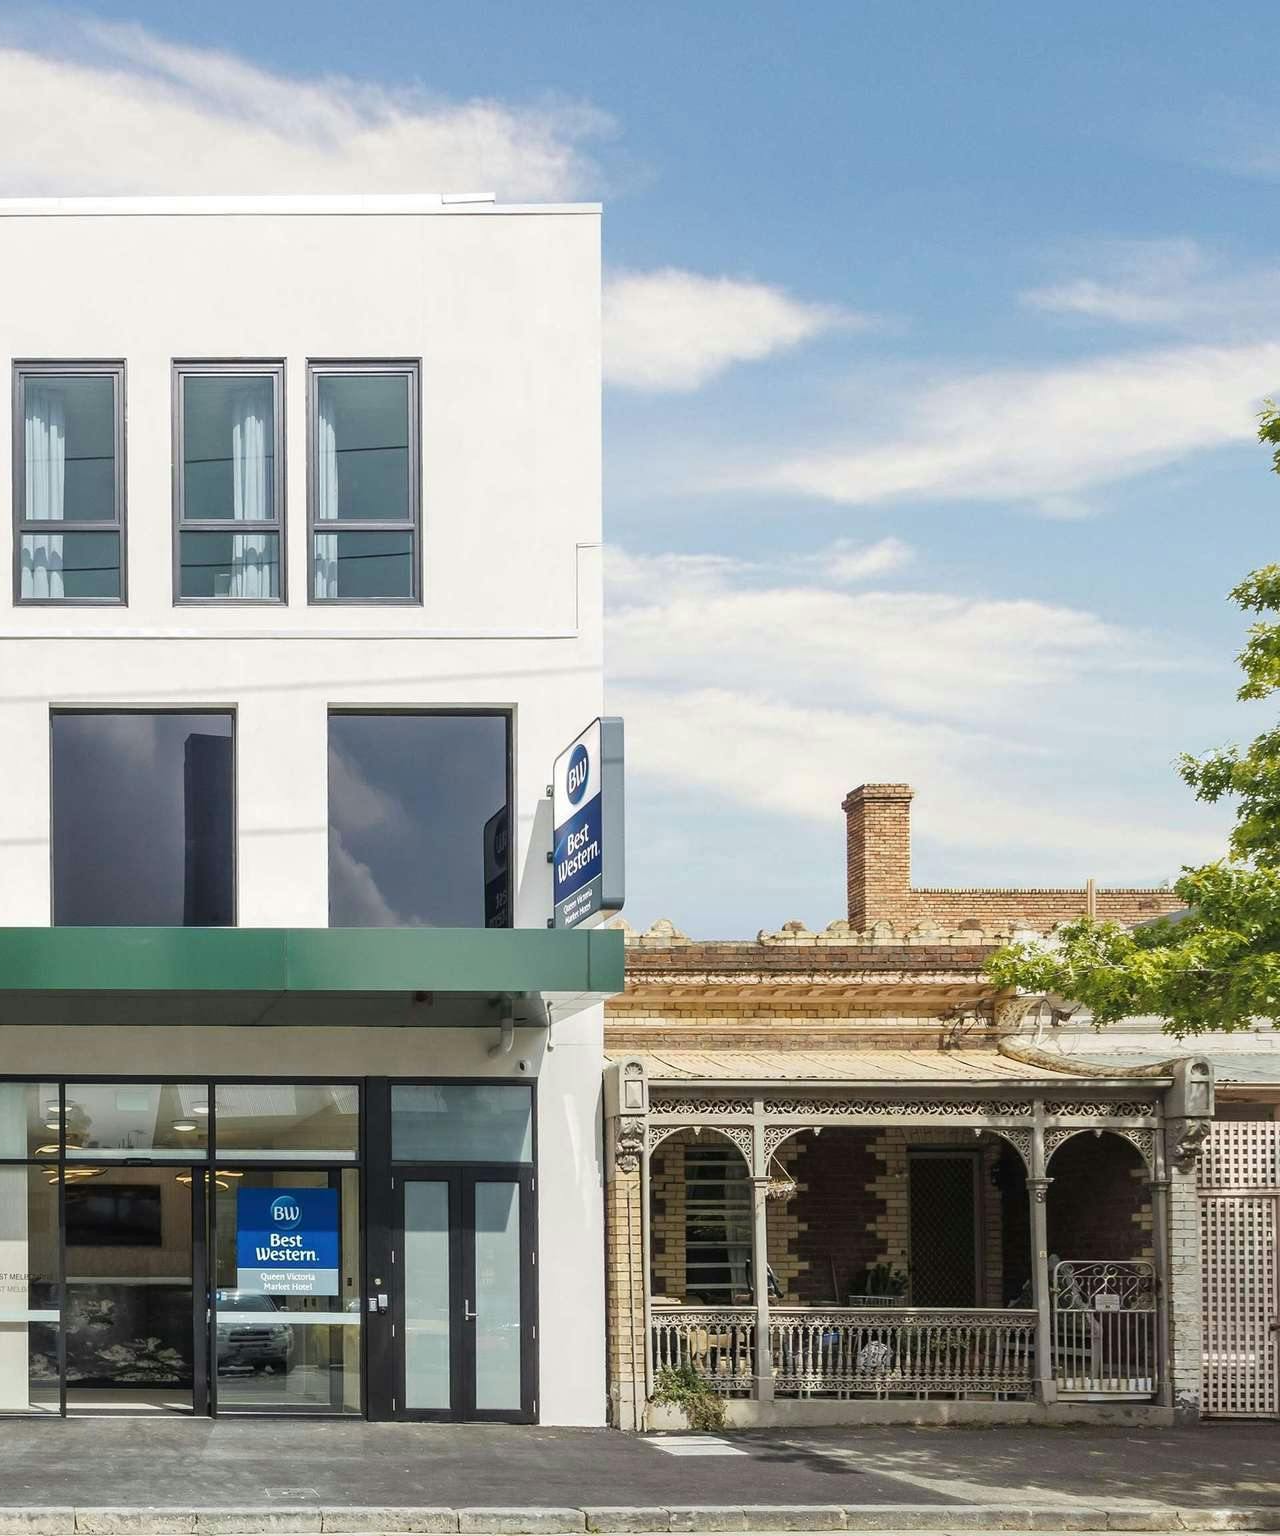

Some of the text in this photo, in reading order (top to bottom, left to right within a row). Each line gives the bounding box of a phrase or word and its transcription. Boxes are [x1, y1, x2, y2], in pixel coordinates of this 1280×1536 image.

[567, 757, 587, 794] BW
[567, 824, 589, 855] Best
[273, 1206, 300, 1221] BW
[270, 1233, 303, 1247] Best
[260, 1272, 316, 1282] Queen Victoria
[264, 1282, 313, 1291] Market Hotel
